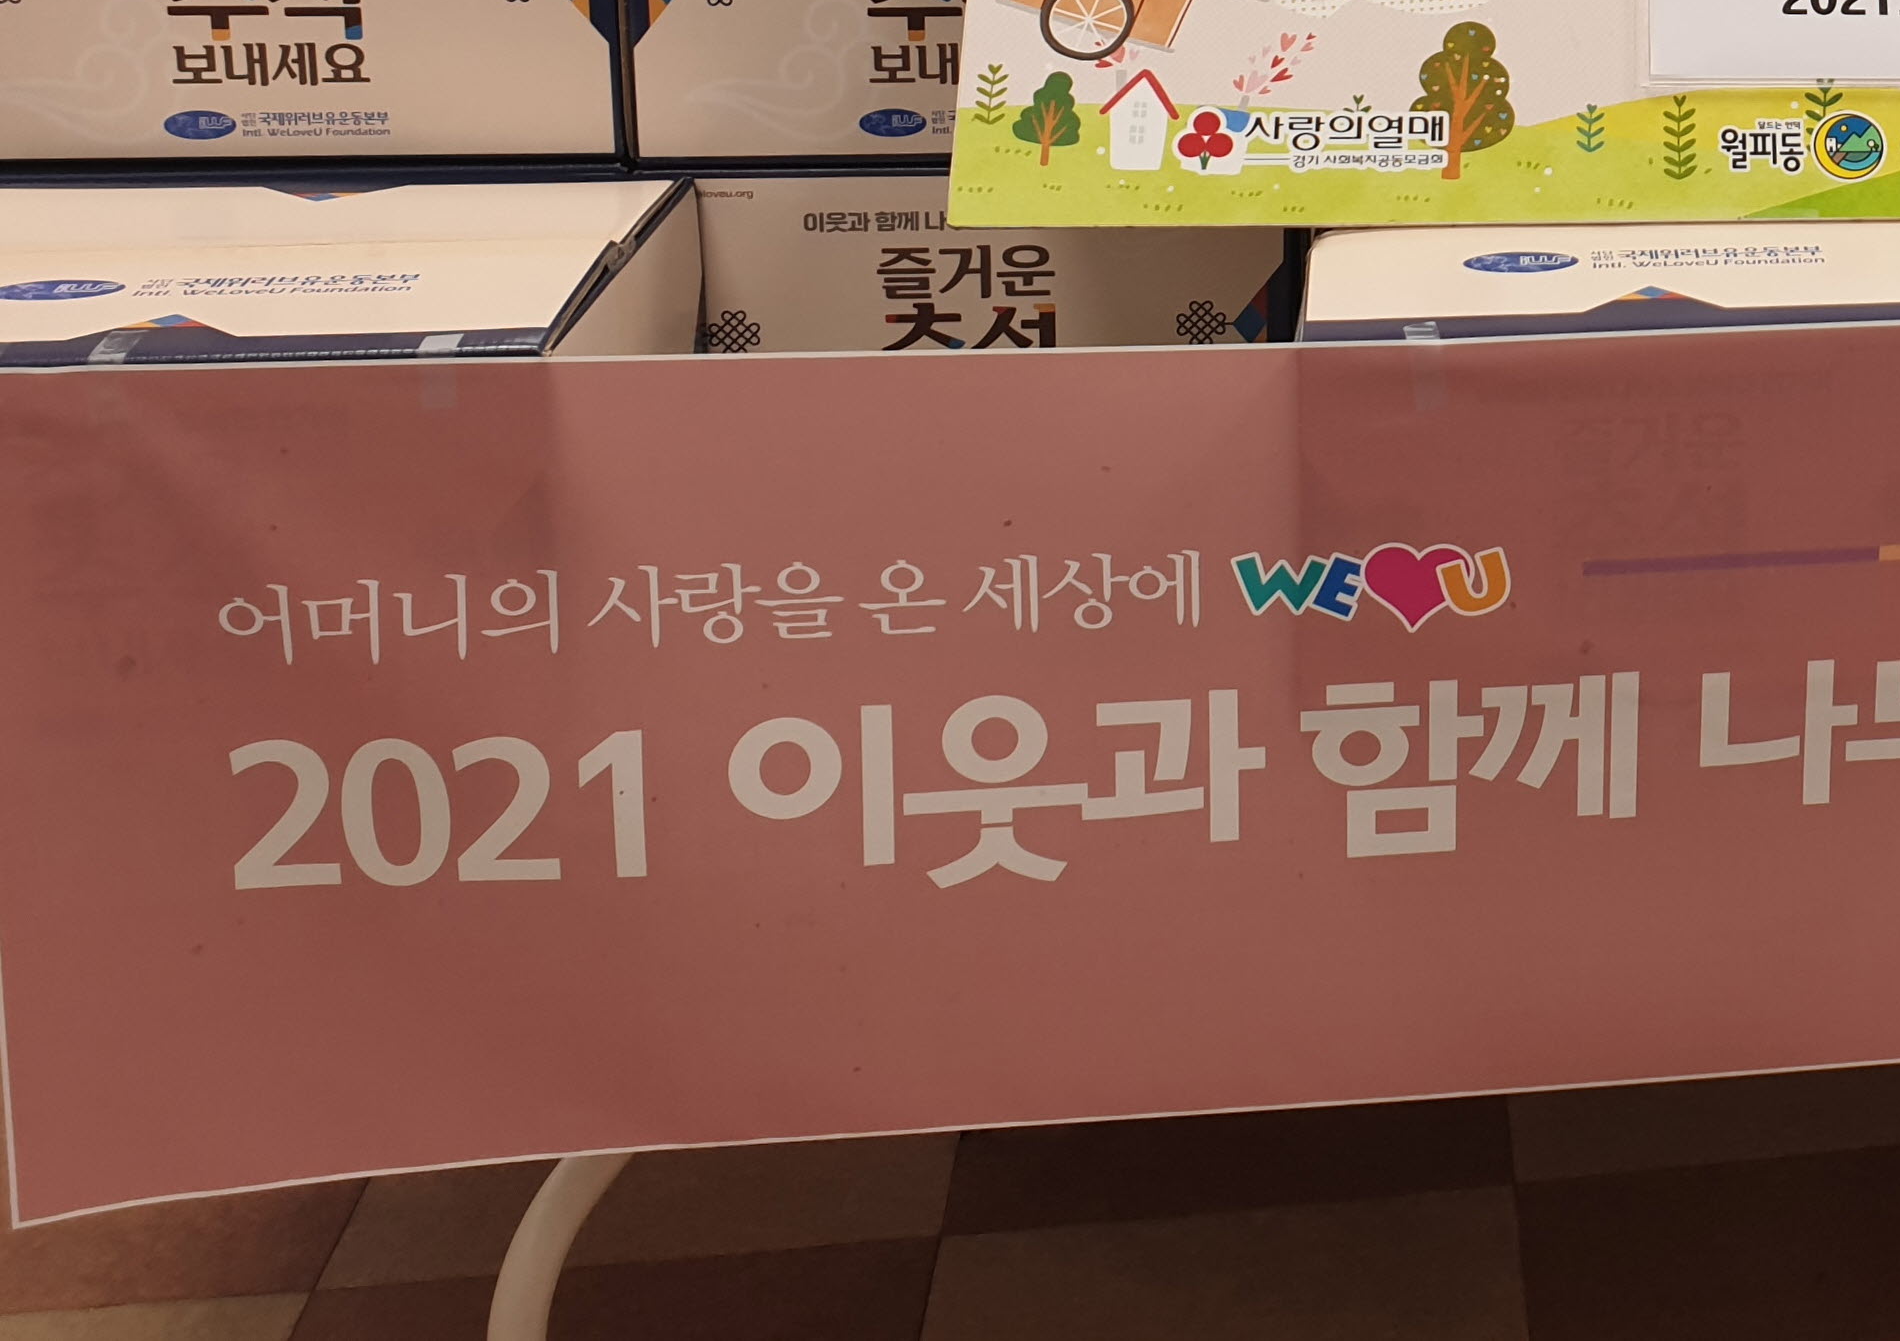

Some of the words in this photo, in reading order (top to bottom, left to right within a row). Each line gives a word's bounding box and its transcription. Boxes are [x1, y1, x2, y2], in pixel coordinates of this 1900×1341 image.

[171, 42, 372, 88] 보내세요
[1244, 112, 1447, 150] 사랑의열매
[1720, 128, 1804, 172] 월피동
[1292, 152, 1321, 169] 경기
[1323, 152, 1445, 169] 사회복지공동모금회
[876, 243, 1056, 300] 즐거운
[217, 569, 559, 665] 어머니의
[587, 560, 845, 645] 사랑을
[858, 559, 947, 636] 온
[962, 549, 1200, 634] 세상에
[228, 729, 648, 891] 2021
[727, 688, 1267, 890] 이웃과
[1300, 671, 1640, 859] 함께
